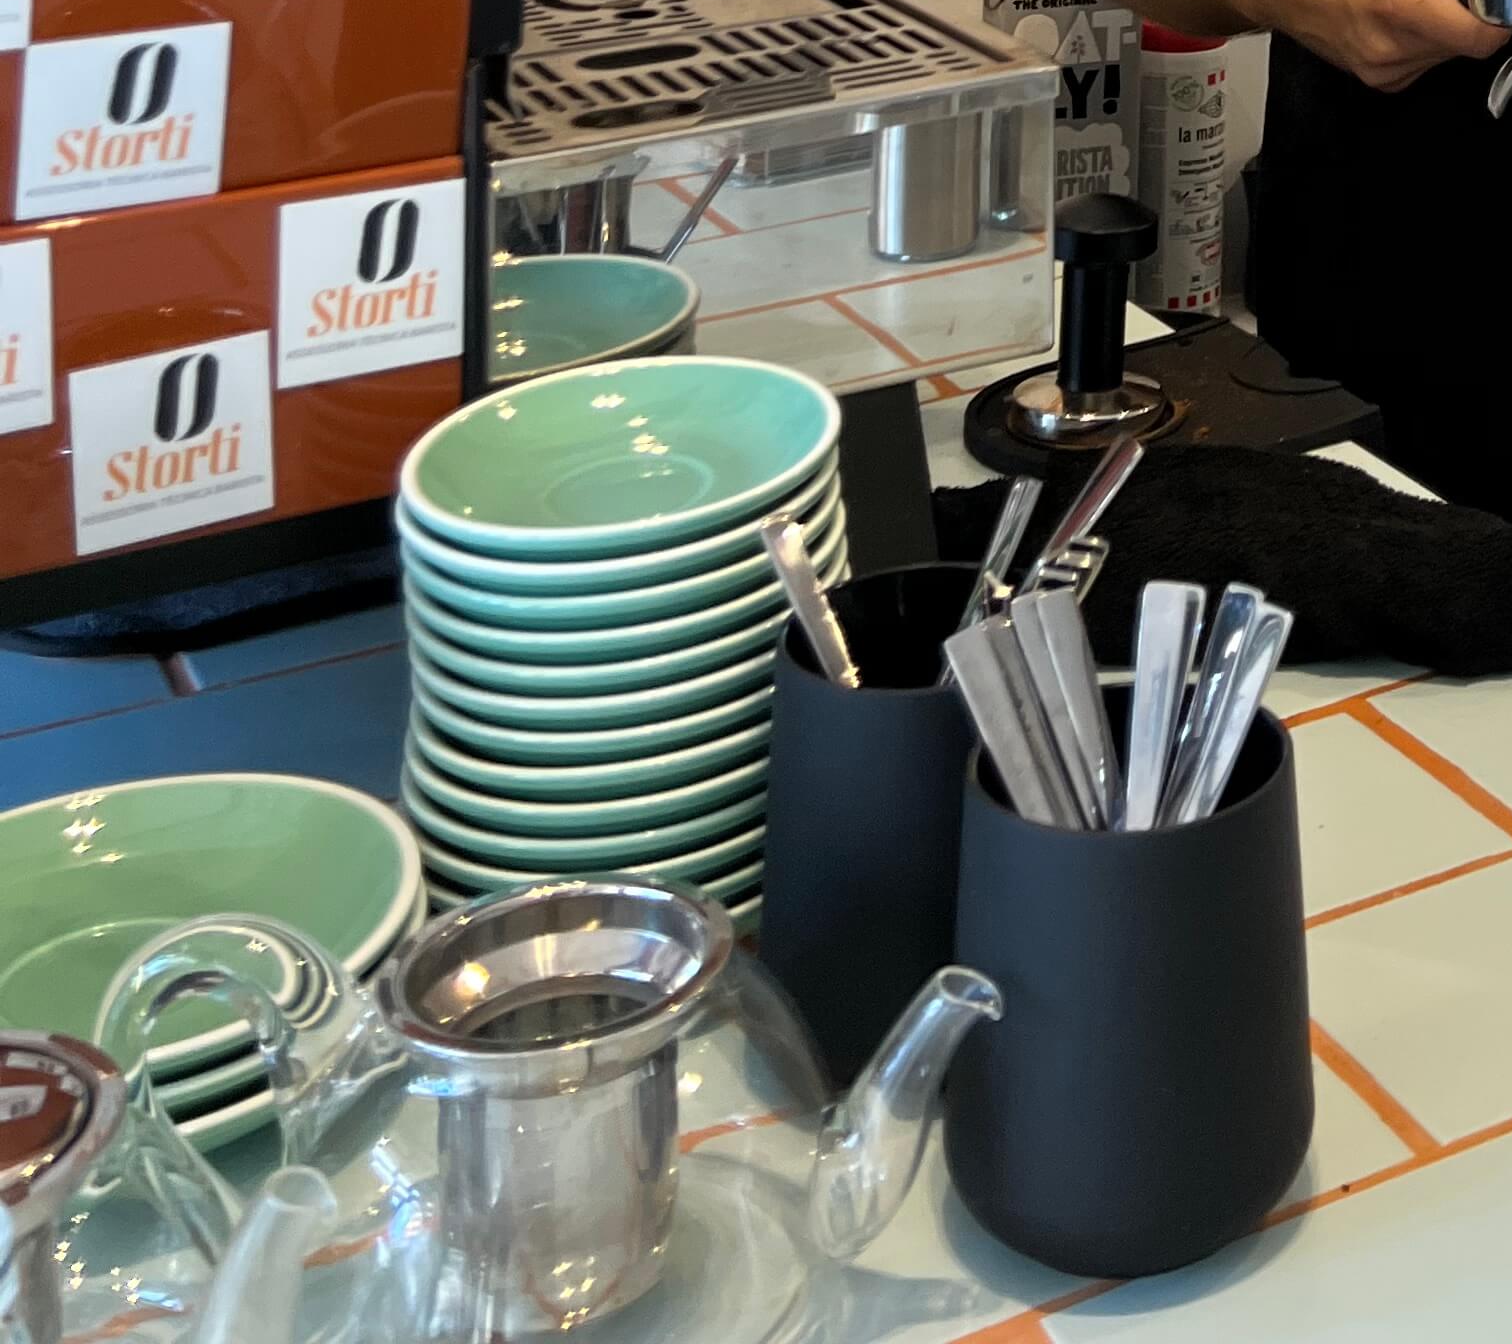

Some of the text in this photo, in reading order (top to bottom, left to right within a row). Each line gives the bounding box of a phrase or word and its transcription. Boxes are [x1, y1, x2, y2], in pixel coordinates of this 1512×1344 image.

[1056, 64, 1121, 120] Y!
[50, 112, 194, 178] Storti
[1057, 144, 1113, 176] RISTA
[1178, 127, 1192, 143] la
[306, 269, 440, 339] Storti
[102, 422, 242, 502] Storti
